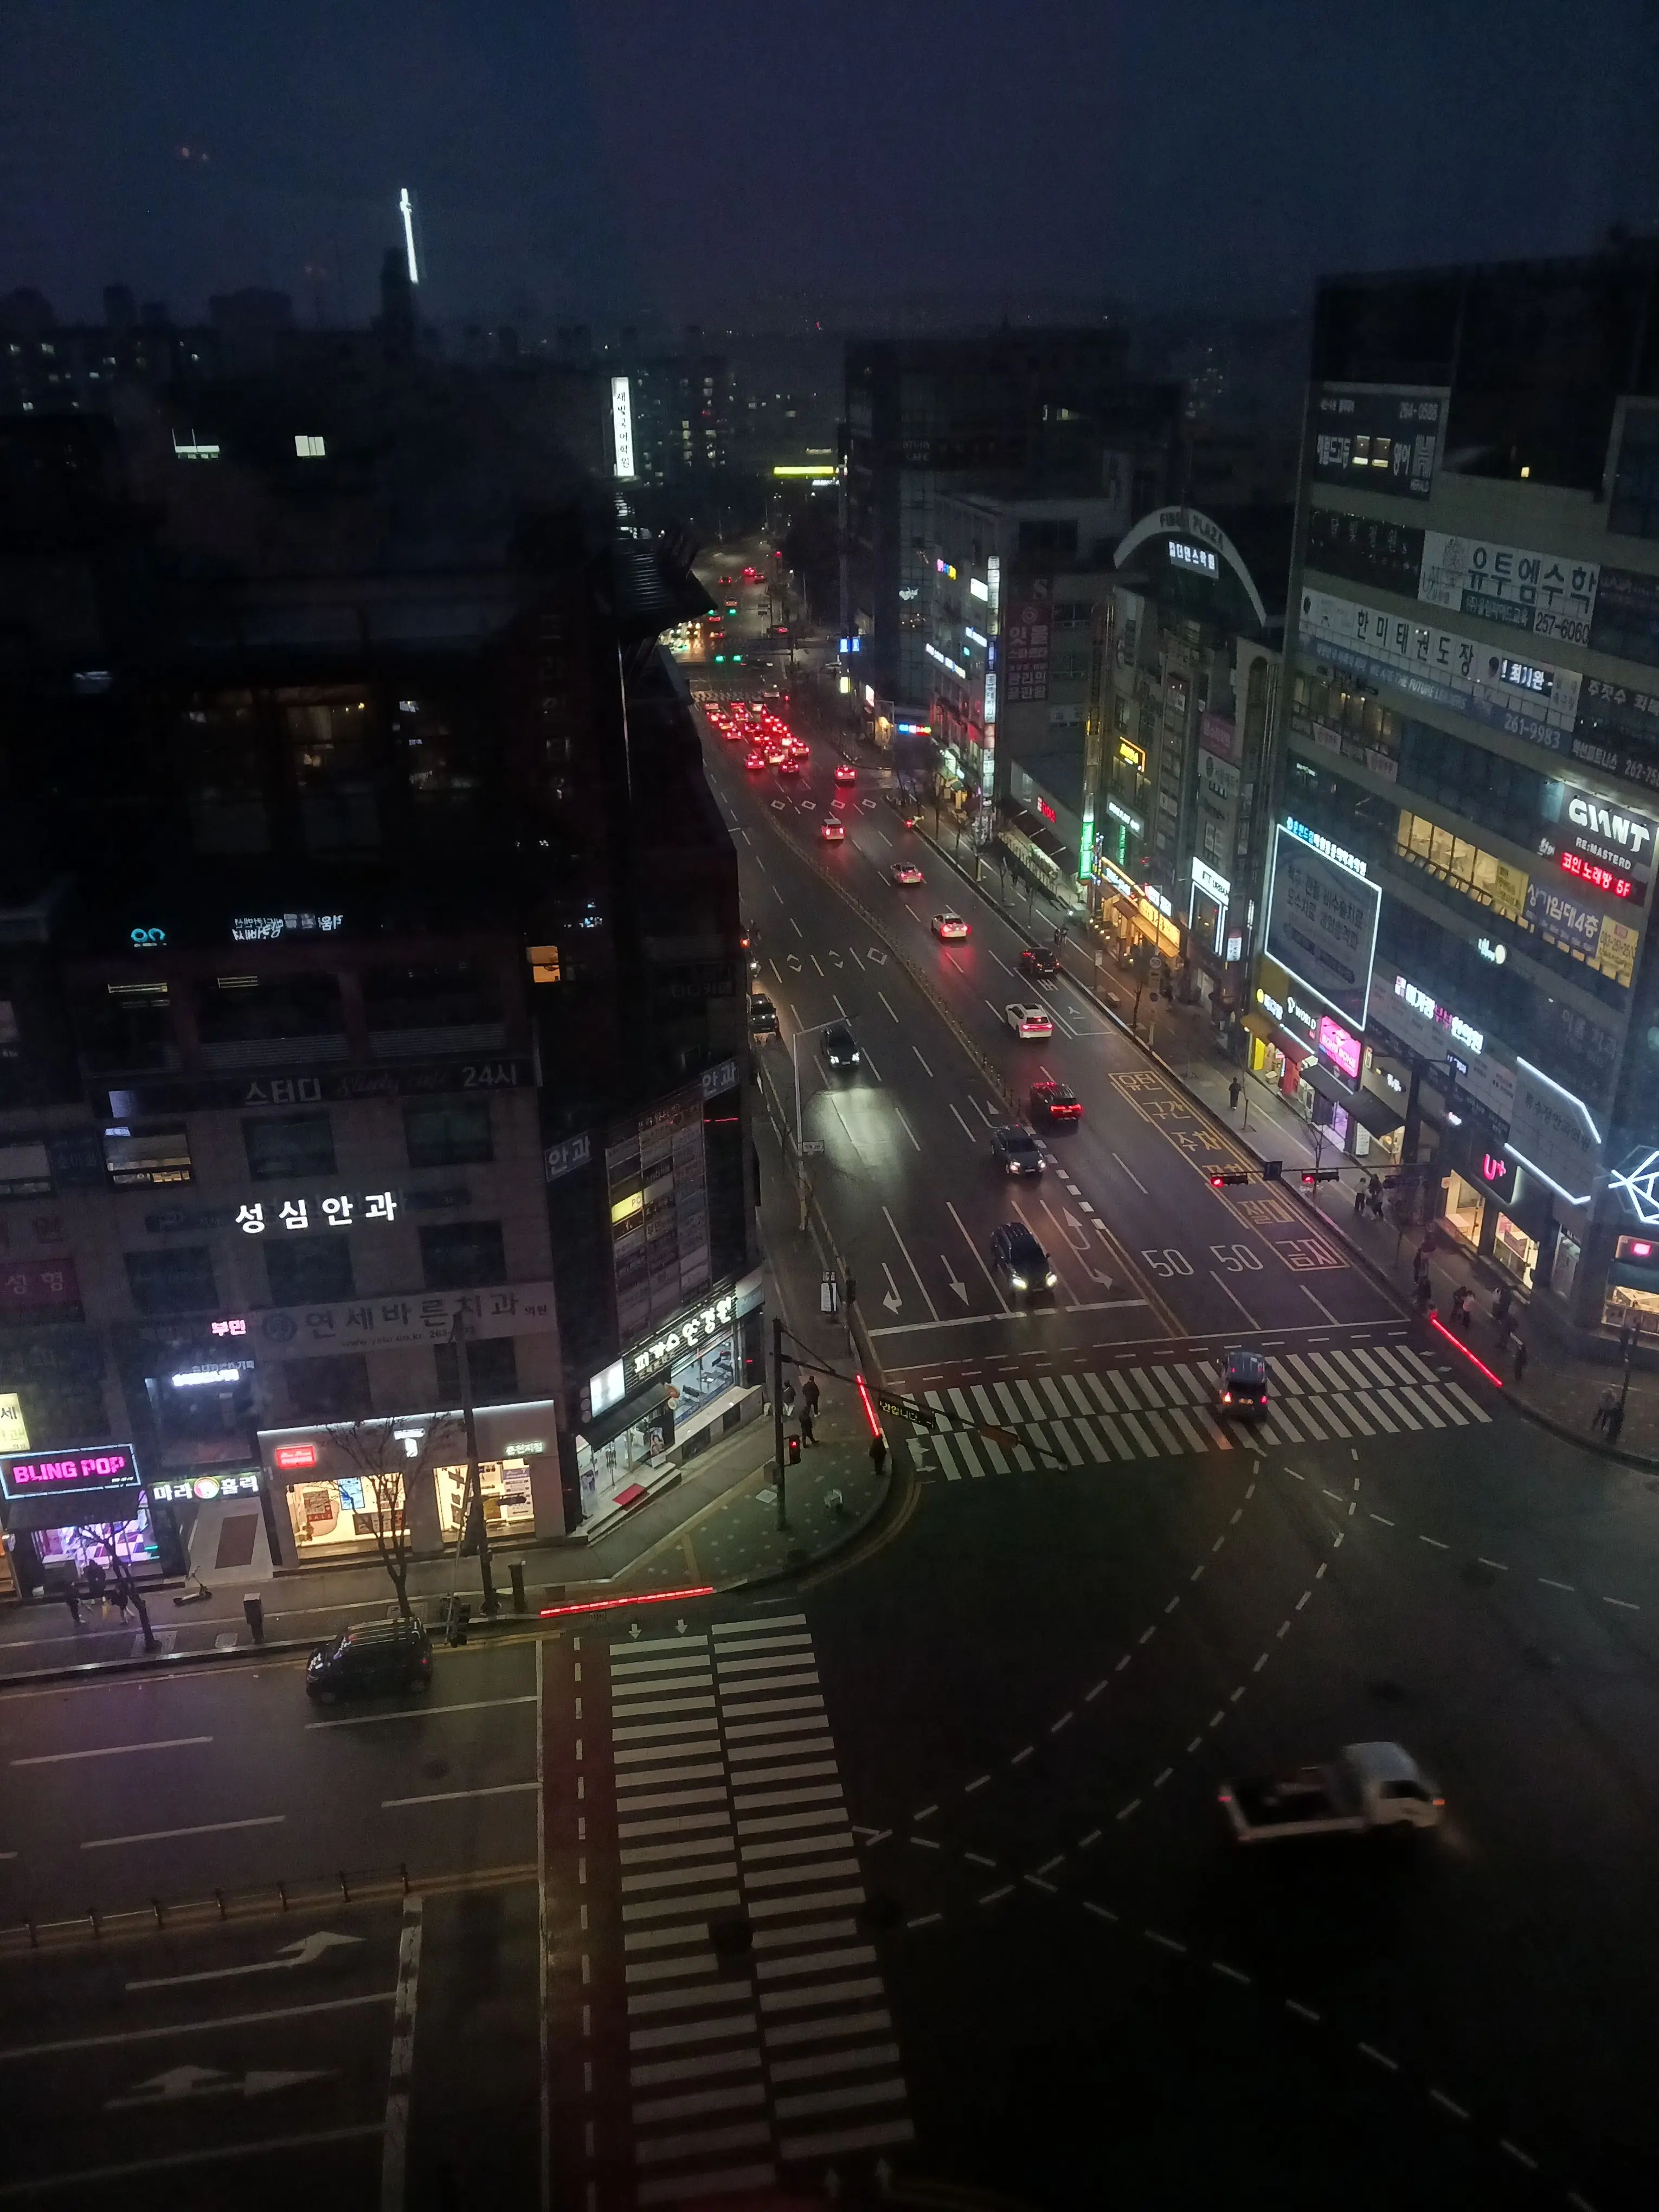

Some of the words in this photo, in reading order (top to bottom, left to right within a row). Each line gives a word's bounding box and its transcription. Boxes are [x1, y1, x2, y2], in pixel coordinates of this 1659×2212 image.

[1468, 547, 1595, 613] 유투엠수학
[1357, 609, 1474, 677] 한미태권도장
[1296, 1006, 1316, 1030] WORLD
[246, 1079, 321, 1105] 스터디
[462, 1063, 517, 1087] 24시
[703, 1061, 738, 1095] 안과
[1142, 1101, 1191, 1120] 구간
[549, 1136, 590, 1175] 안과
[235, 1192, 397, 1234] 성심안과
[1141, 1249, 1194, 1277] 50
[1210, 1244, 1263, 1271] 50
[1276, 1239, 1338, 1267] 금지
[211, 1320, 246, 1336] 부민
[305, 1293, 519, 1340] 연세바른치과
[13, 1461, 78, 1484] BLING
[81, 1456, 125, 1476] POP
[153, 1483, 192, 1501] 마라
[221, 1475, 259, 1495] 홀릭
